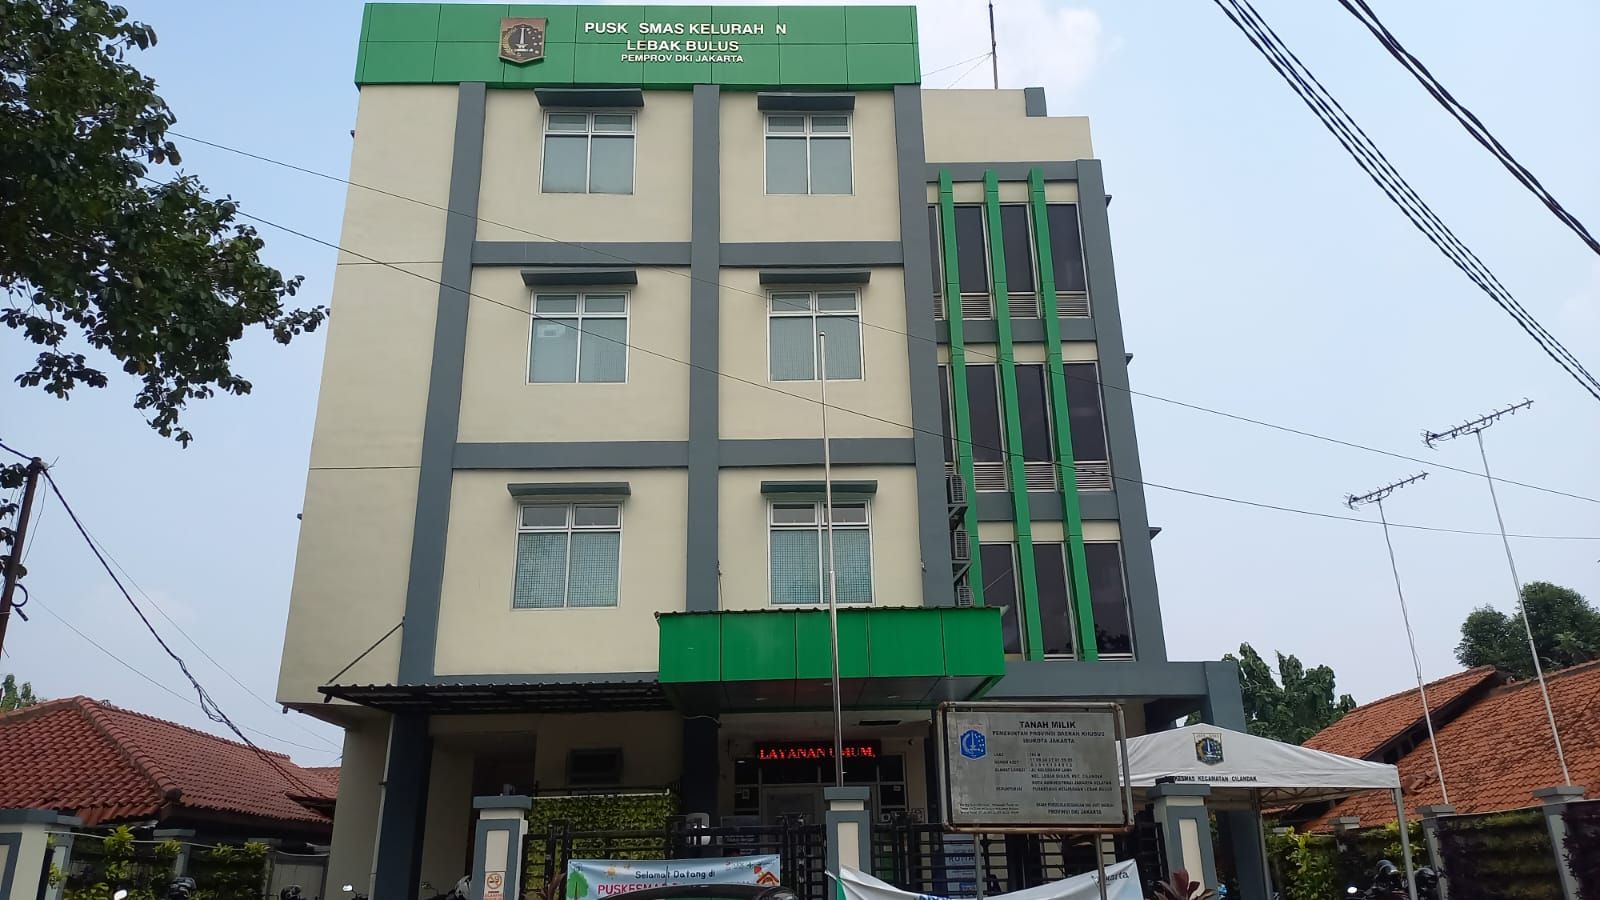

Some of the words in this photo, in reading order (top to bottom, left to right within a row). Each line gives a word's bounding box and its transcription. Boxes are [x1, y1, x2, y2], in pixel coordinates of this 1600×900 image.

[627, 40, 681, 51] LEBAK
[686, 40, 739, 51] BULUS
[621, 54, 672, 62] PEMPROV
[675, 54, 693, 62] DKI
[695, 54, 744, 62] JAKARTA
[1019, 721, 1049, 729] TANAH
[1051, 721, 1077, 729] MILIK
[760, 748, 826, 759] LAYANAN
[1231, 775, 1258, 783] CILANDAK
[635, 870, 671, 880] Selamat
[673, 870, 706, 879] Datang
[708, 869, 716, 878] di
